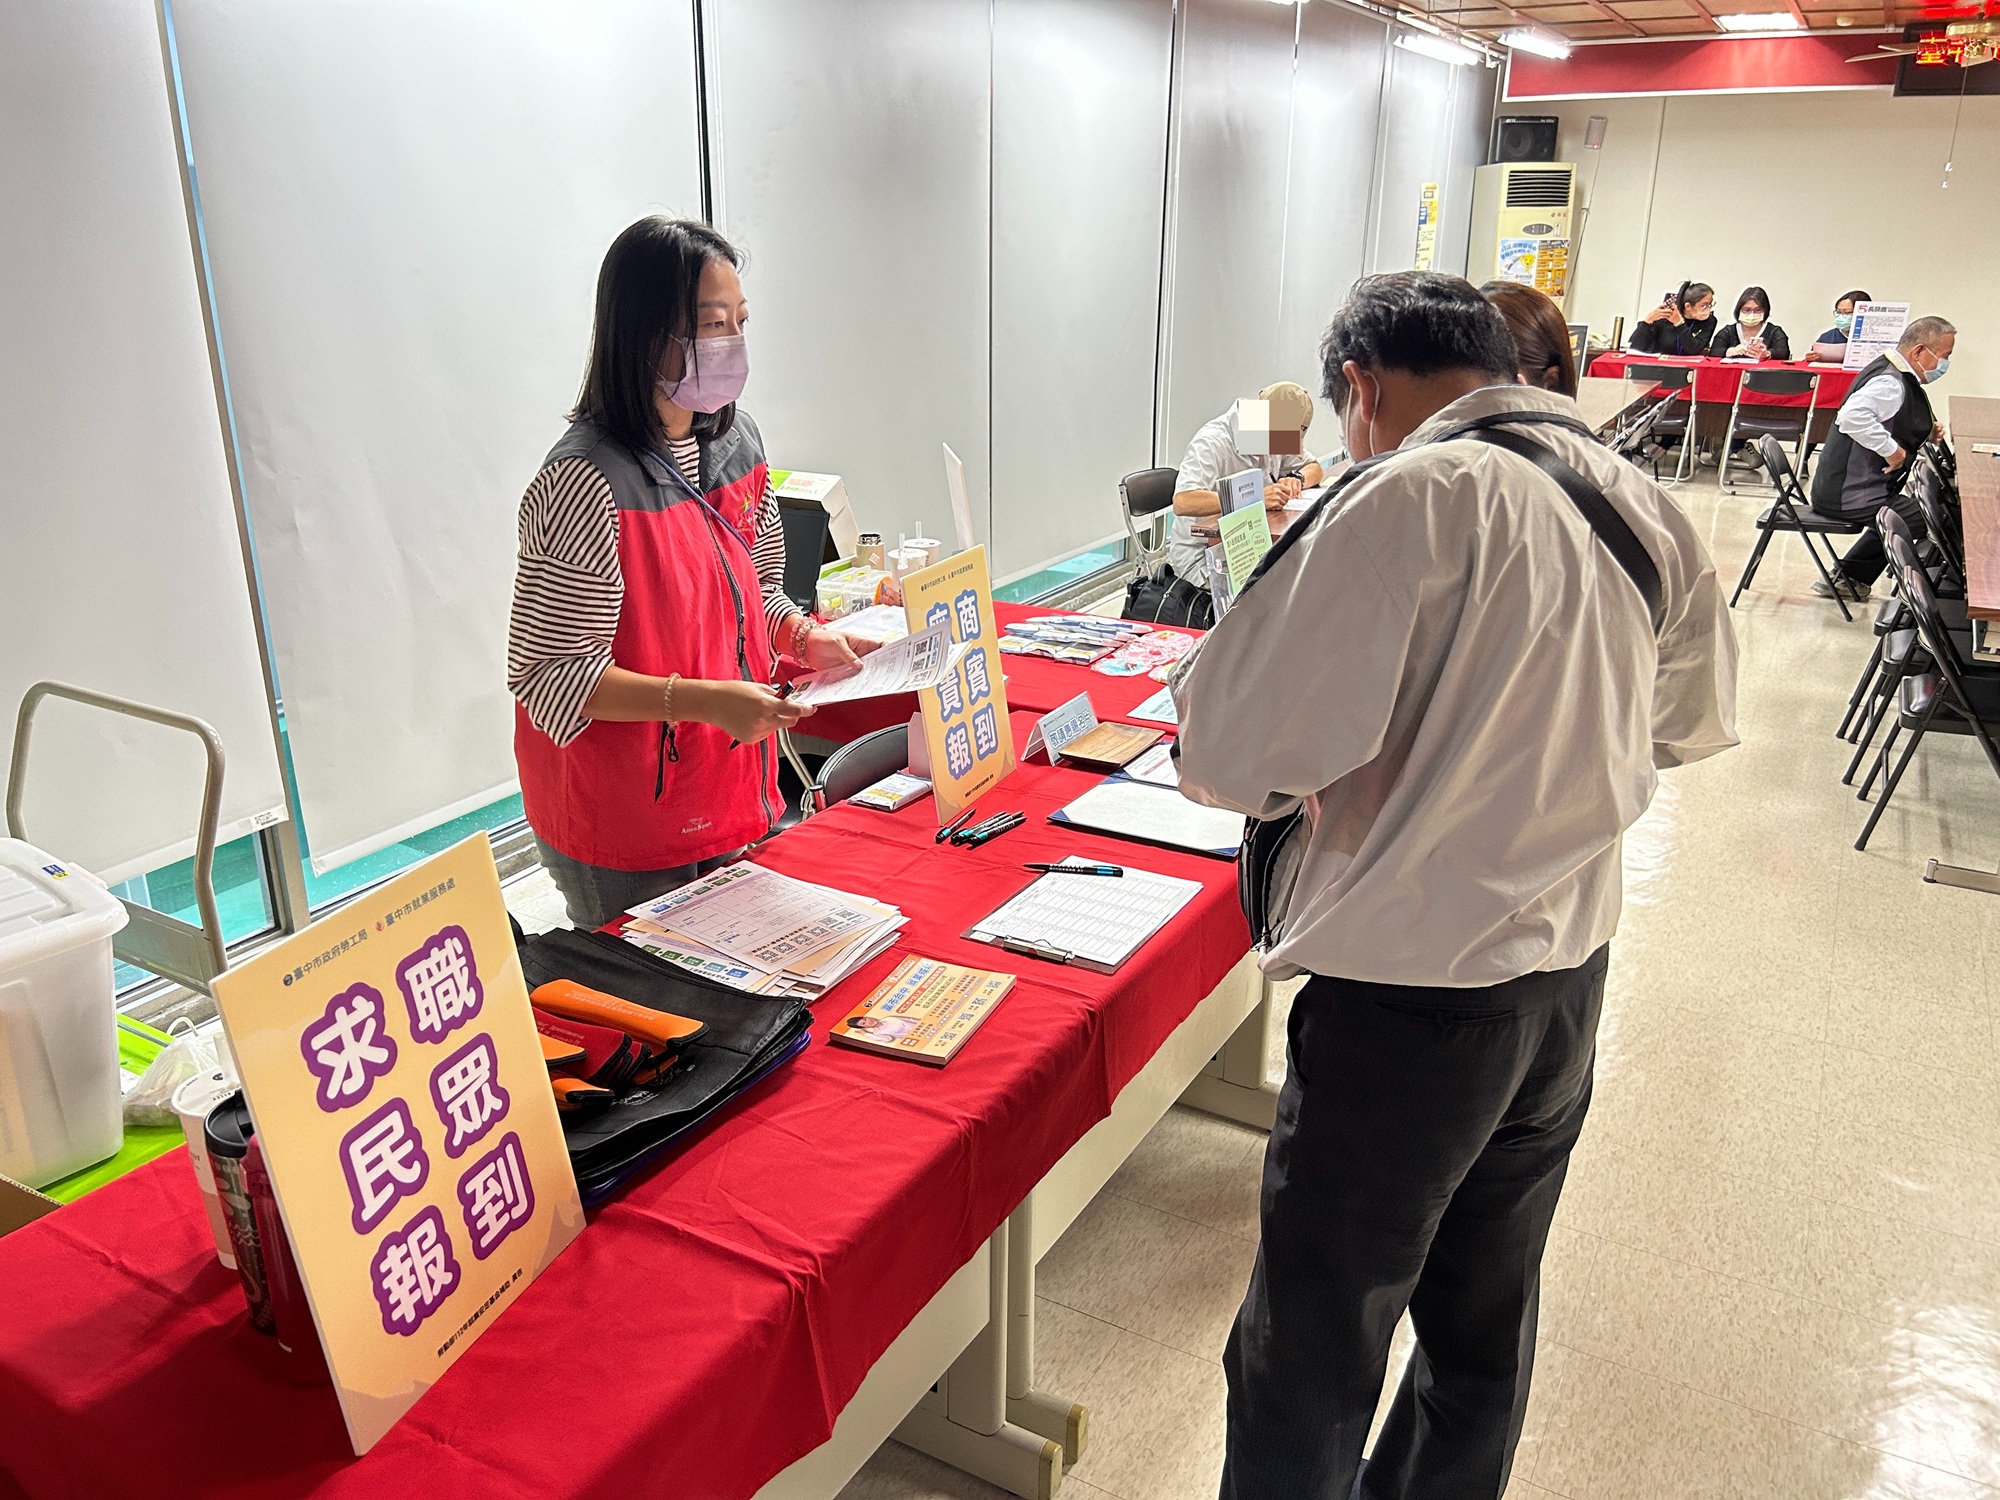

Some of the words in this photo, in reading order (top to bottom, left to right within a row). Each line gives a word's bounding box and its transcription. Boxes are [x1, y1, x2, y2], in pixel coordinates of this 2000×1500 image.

[947, 713, 997, 777] 報到
[293, 928, 368, 981] 臺中市政府勞工局
[385, 877, 456, 927] 臺中市就業服務處
[309, 934, 479, 1102] 求職
[346, 1046, 506, 1224] 民眾
[377, 1142, 530, 1325] 報到
